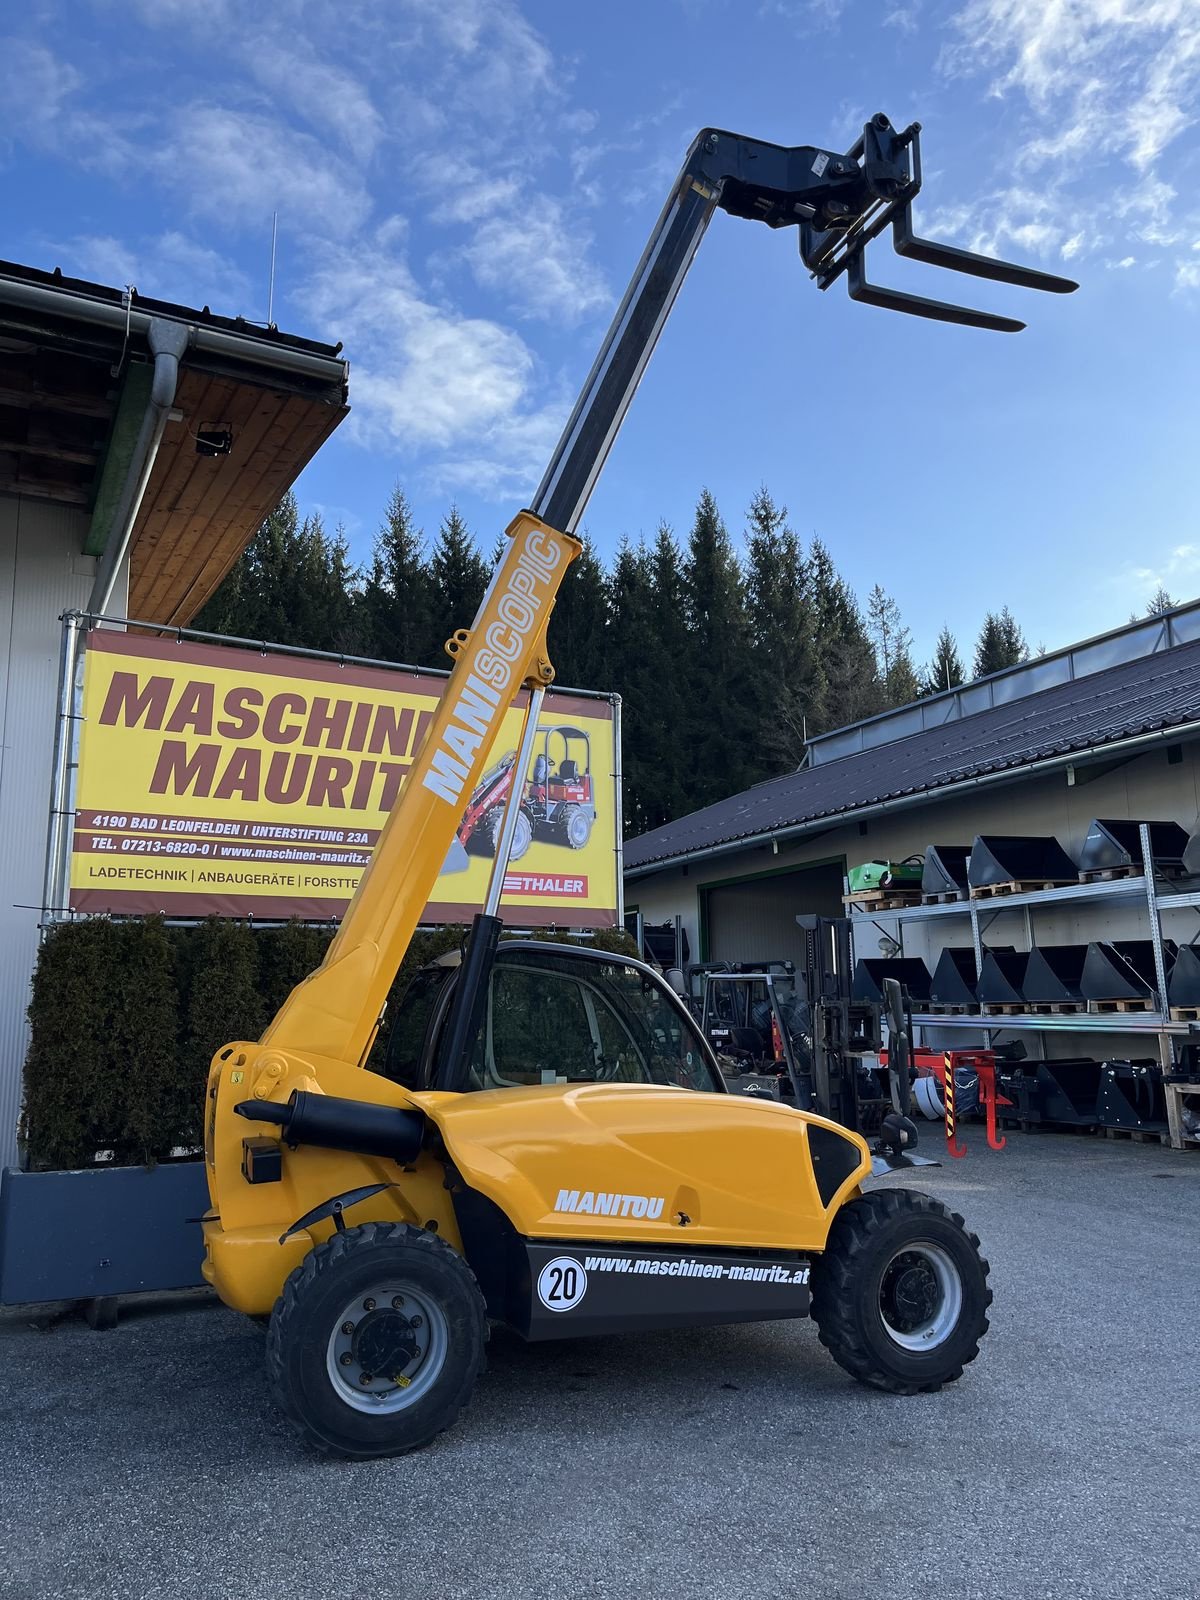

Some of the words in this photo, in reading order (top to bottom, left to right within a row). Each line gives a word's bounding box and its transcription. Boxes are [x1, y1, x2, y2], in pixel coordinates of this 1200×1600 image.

[423, 531, 561, 806] MANISCOPIC
[92, 815, 127, 828] 4190
[130, 817, 158, 830] BAD
[161, 820, 240, 836] LEONFELDEN
[251, 826, 344, 842] UNTERSTIFTUNG
[346, 832, 369, 843] 23A
[92, 837, 117, 850] TEL.
[121, 839, 210, 855] 07213-6820-0
[89, 866, 188, 881] LADETECHNIK
[197, 872, 295, 886] ANBAUGERÄTE
[554, 1190, 665, 1219] MANITOU
[548, 1267, 577, 1301] 20
[584, 1257, 810, 1285] www.maschinen-mauritz.at
